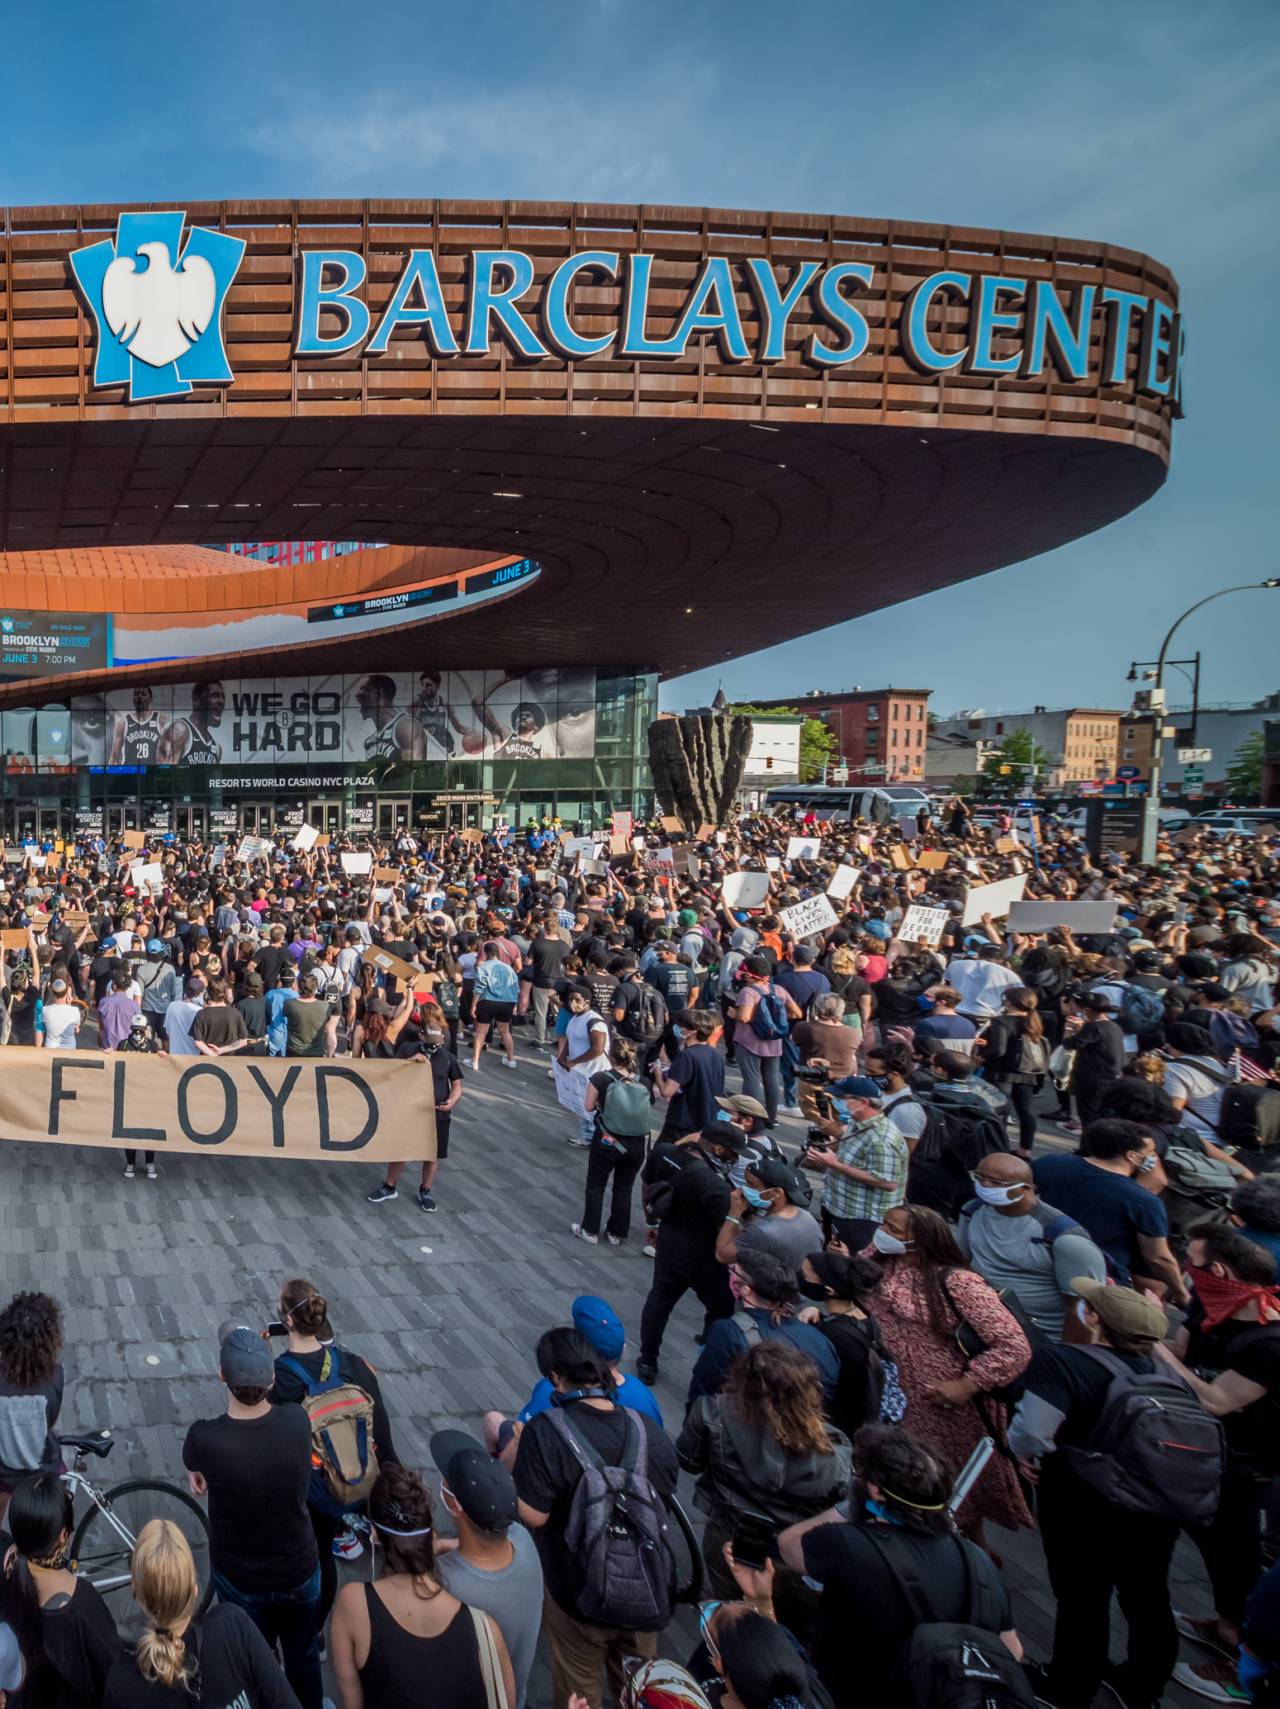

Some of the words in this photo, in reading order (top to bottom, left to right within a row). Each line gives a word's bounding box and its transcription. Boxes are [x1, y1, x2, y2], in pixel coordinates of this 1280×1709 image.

[293, 249, 874, 366] BARCLAYS
[904, 270, 1186, 405] CENTER
[492, 563, 521, 585] JUNE
[523, 559, 530, 573] 3
[364, 594, 409, 609] BROOKLYN
[2, 635, 60, 647] BROOKLYN
[2, 653, 29, 664] JUNE
[31, 654, 38, 664] 3
[45, 655, 62, 664] 7:00
[64, 655, 76, 664] PM
[232, 692, 284, 717] WE
[290, 692, 342, 716] GO
[127, 730, 160, 744] BROOKLYN
[232, 721, 342, 752] HARD
[136, 743, 149, 759] 26
[209, 778, 252, 788] RESORTS
[252, 778, 286, 787] WORLD
[287, 777, 321, 787] CASINO
[323, 777, 342, 787] NYC
[343, 777, 375, 786] PLAZA
[787, 898, 821, 919] BLACK
[909, 908, 948, 920] JUSTICE
[794, 907, 825, 927] LIVES
[795, 913, 834, 936] MATTER
[918, 916, 933, 925] FOR
[902, 931, 935, 944] FLD
[903, 924, 941, 936] GEORGE
[48, 1057, 382, 1153] FLOYD
